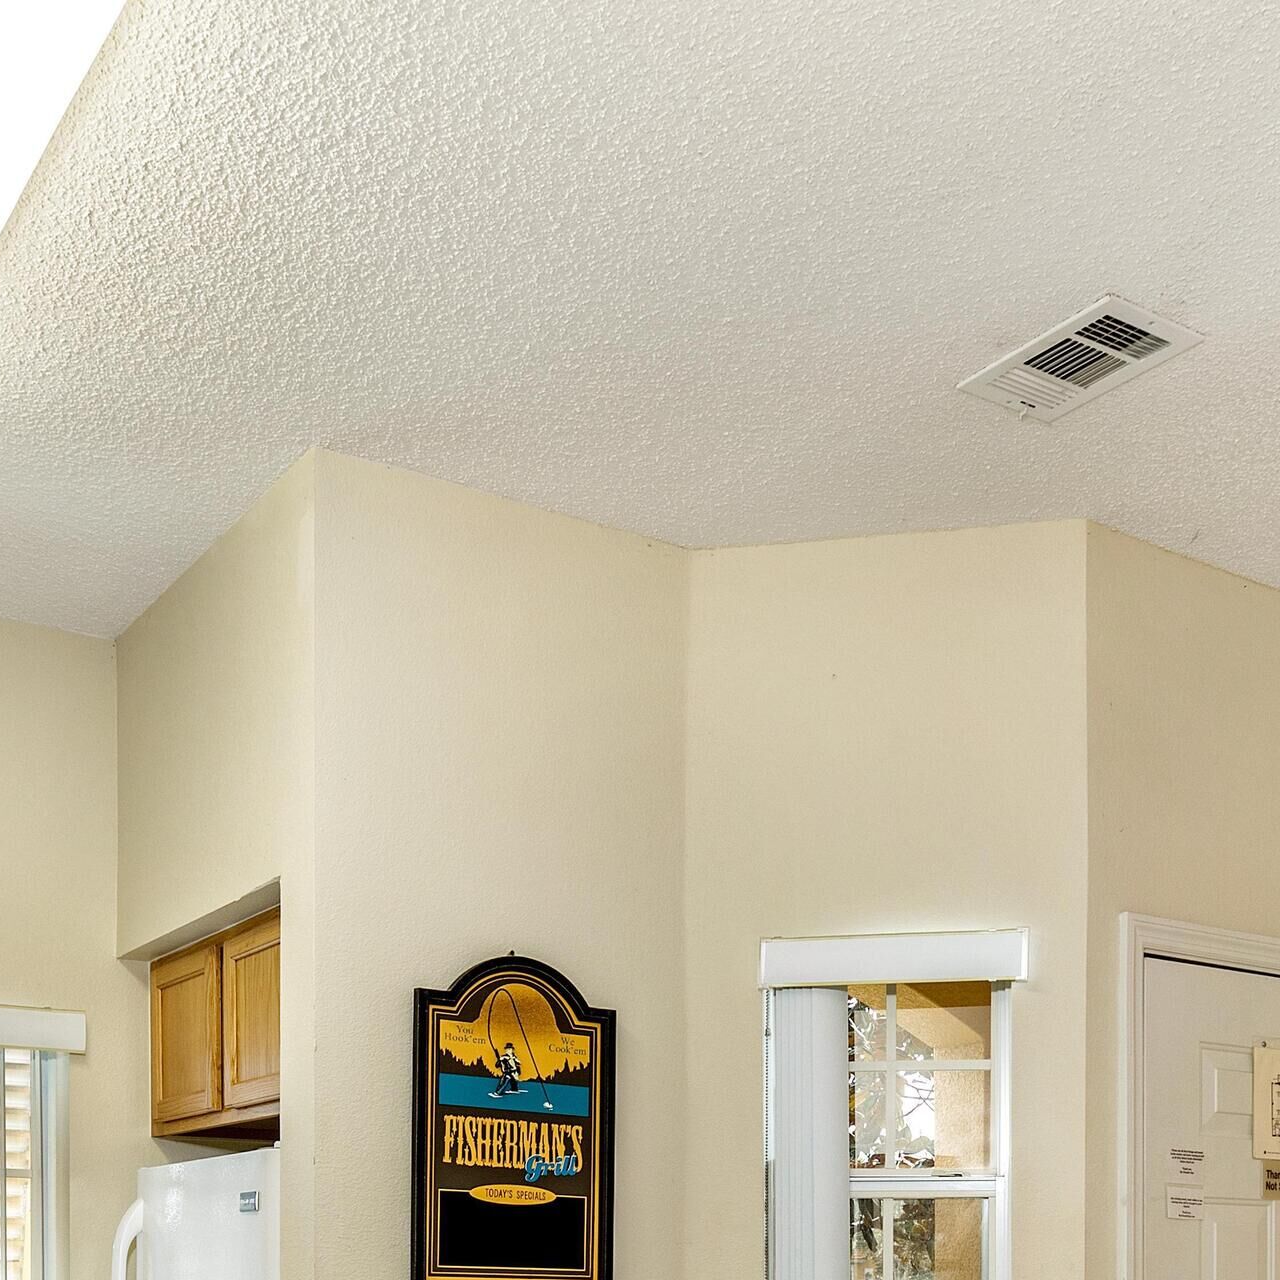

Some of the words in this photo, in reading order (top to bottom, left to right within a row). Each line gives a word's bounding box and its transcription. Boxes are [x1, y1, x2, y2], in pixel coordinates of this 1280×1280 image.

[456, 1025, 474, 1035] You
[561, 1037, 575, 1046] We
[442, 1114, 583, 1173] FISHERMAN'S
[524, 1153, 577, 1182] Grill
[1265, 1181, 1277, 1191] Not
[485, 1188, 513, 1199] TODAY'S
[516, 1190, 546, 1201] SPECIALS
